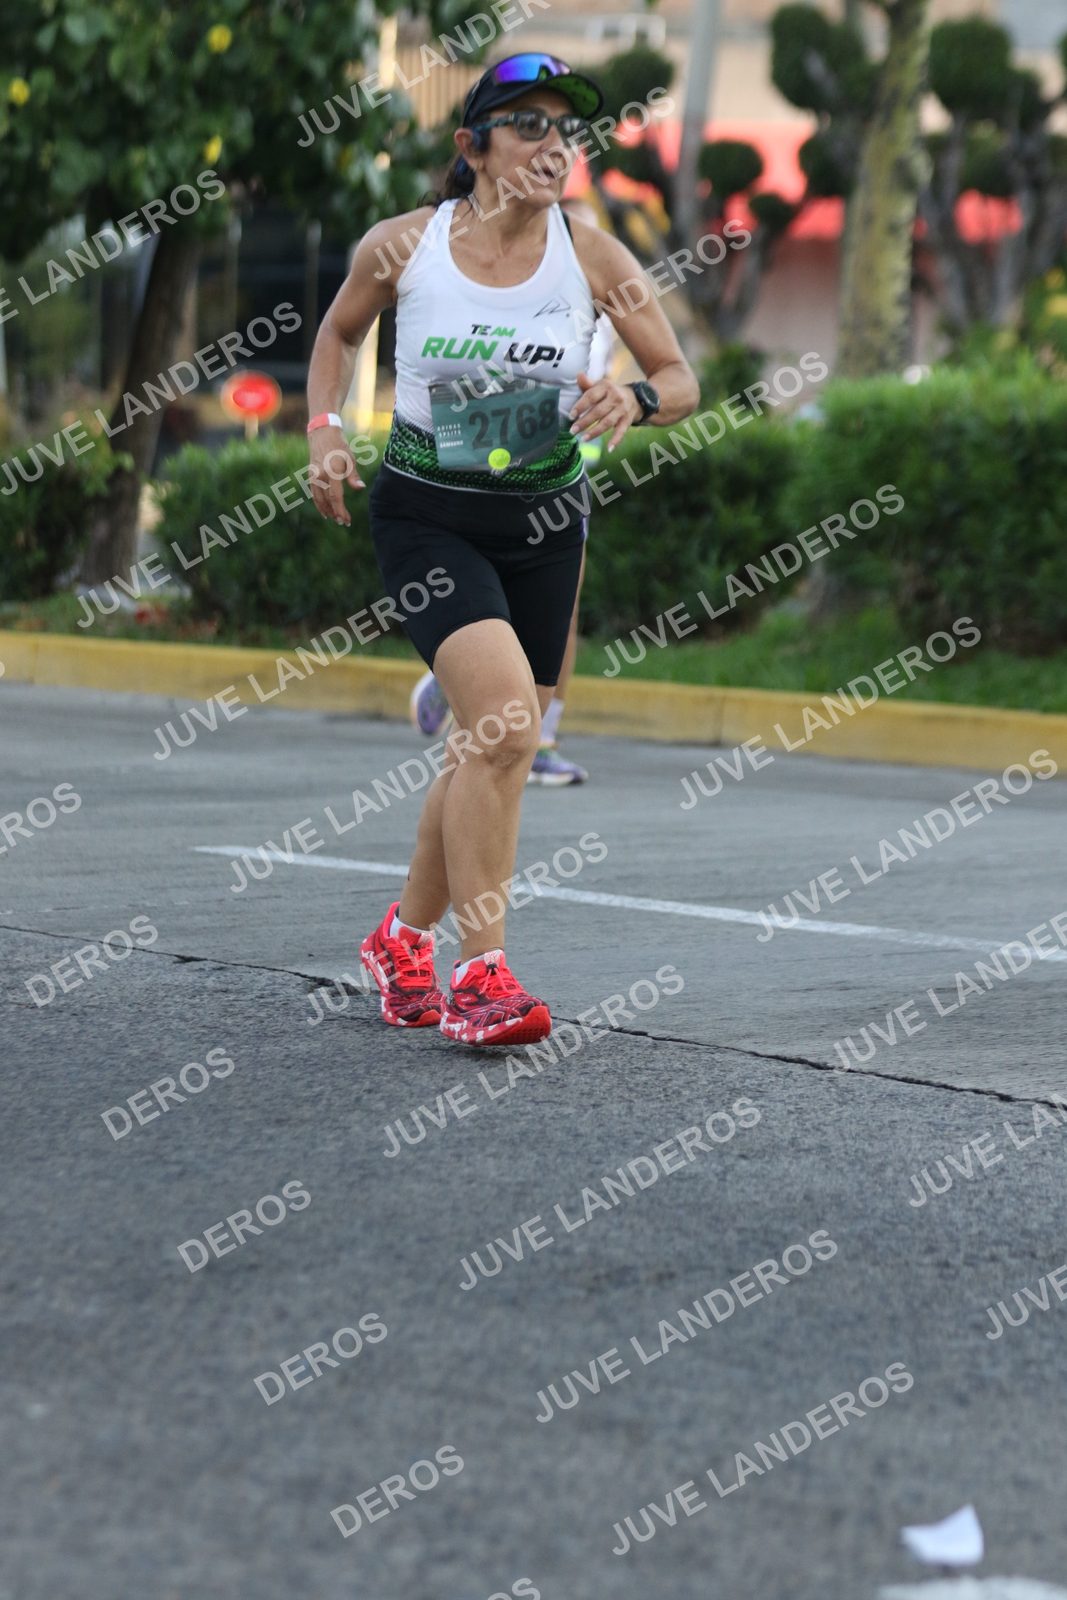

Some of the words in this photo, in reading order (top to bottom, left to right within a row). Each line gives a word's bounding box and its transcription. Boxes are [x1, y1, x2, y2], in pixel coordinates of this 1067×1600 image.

[471, 323, 517, 338] TEAM
[421, 336, 500, 361] RUN
[504, 342, 565, 368] UP!
[468, 400, 557, 450] 2768
